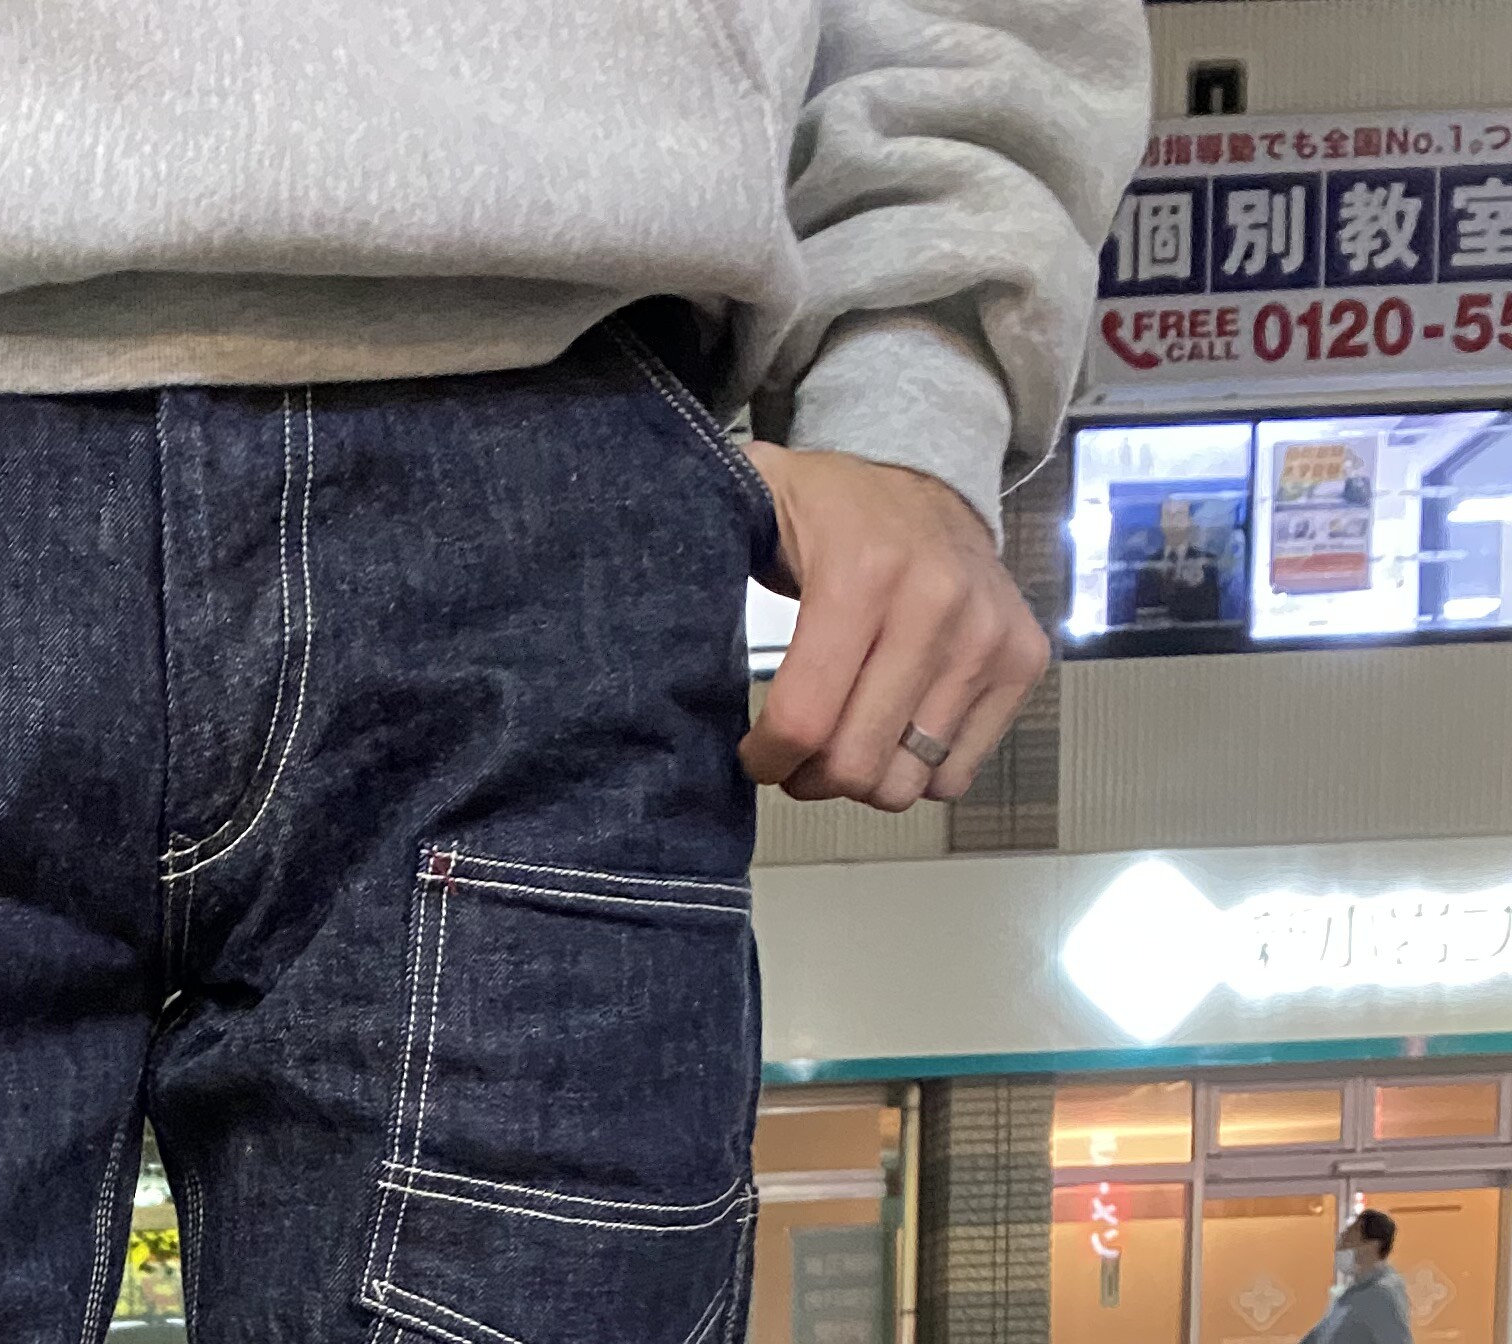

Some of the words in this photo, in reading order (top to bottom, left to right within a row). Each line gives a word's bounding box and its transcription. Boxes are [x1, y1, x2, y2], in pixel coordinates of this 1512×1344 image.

[1111, 177, 1512, 282] 個別教室
[1132, 306, 1240, 341] FREE
[1166, 341, 1240, 363] CALL
